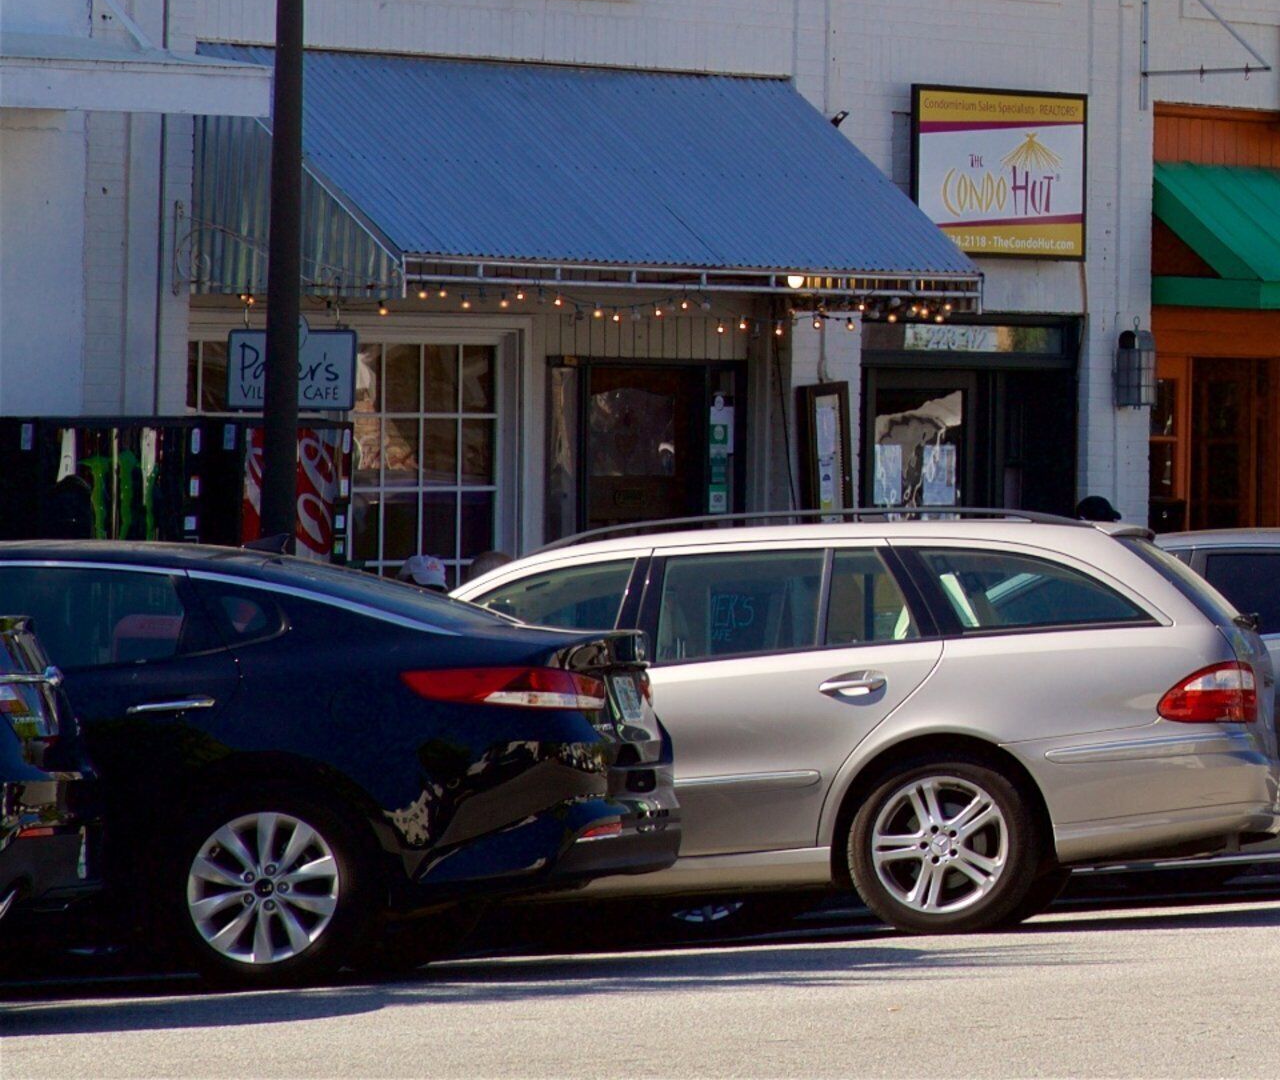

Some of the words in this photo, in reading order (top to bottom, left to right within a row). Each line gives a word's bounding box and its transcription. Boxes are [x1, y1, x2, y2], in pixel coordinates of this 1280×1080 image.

[924, 97, 977, 112] Condominium
[978, 100, 996, 113] Sales
[998, 102, 1035, 118] Specialists
[968, 153, 984, 169] THE
[942, 167, 1008, 217] CONDO
[993, 236, 1074, 250] TheCondoHut.com
[240, 342, 340, 382] Paer's
